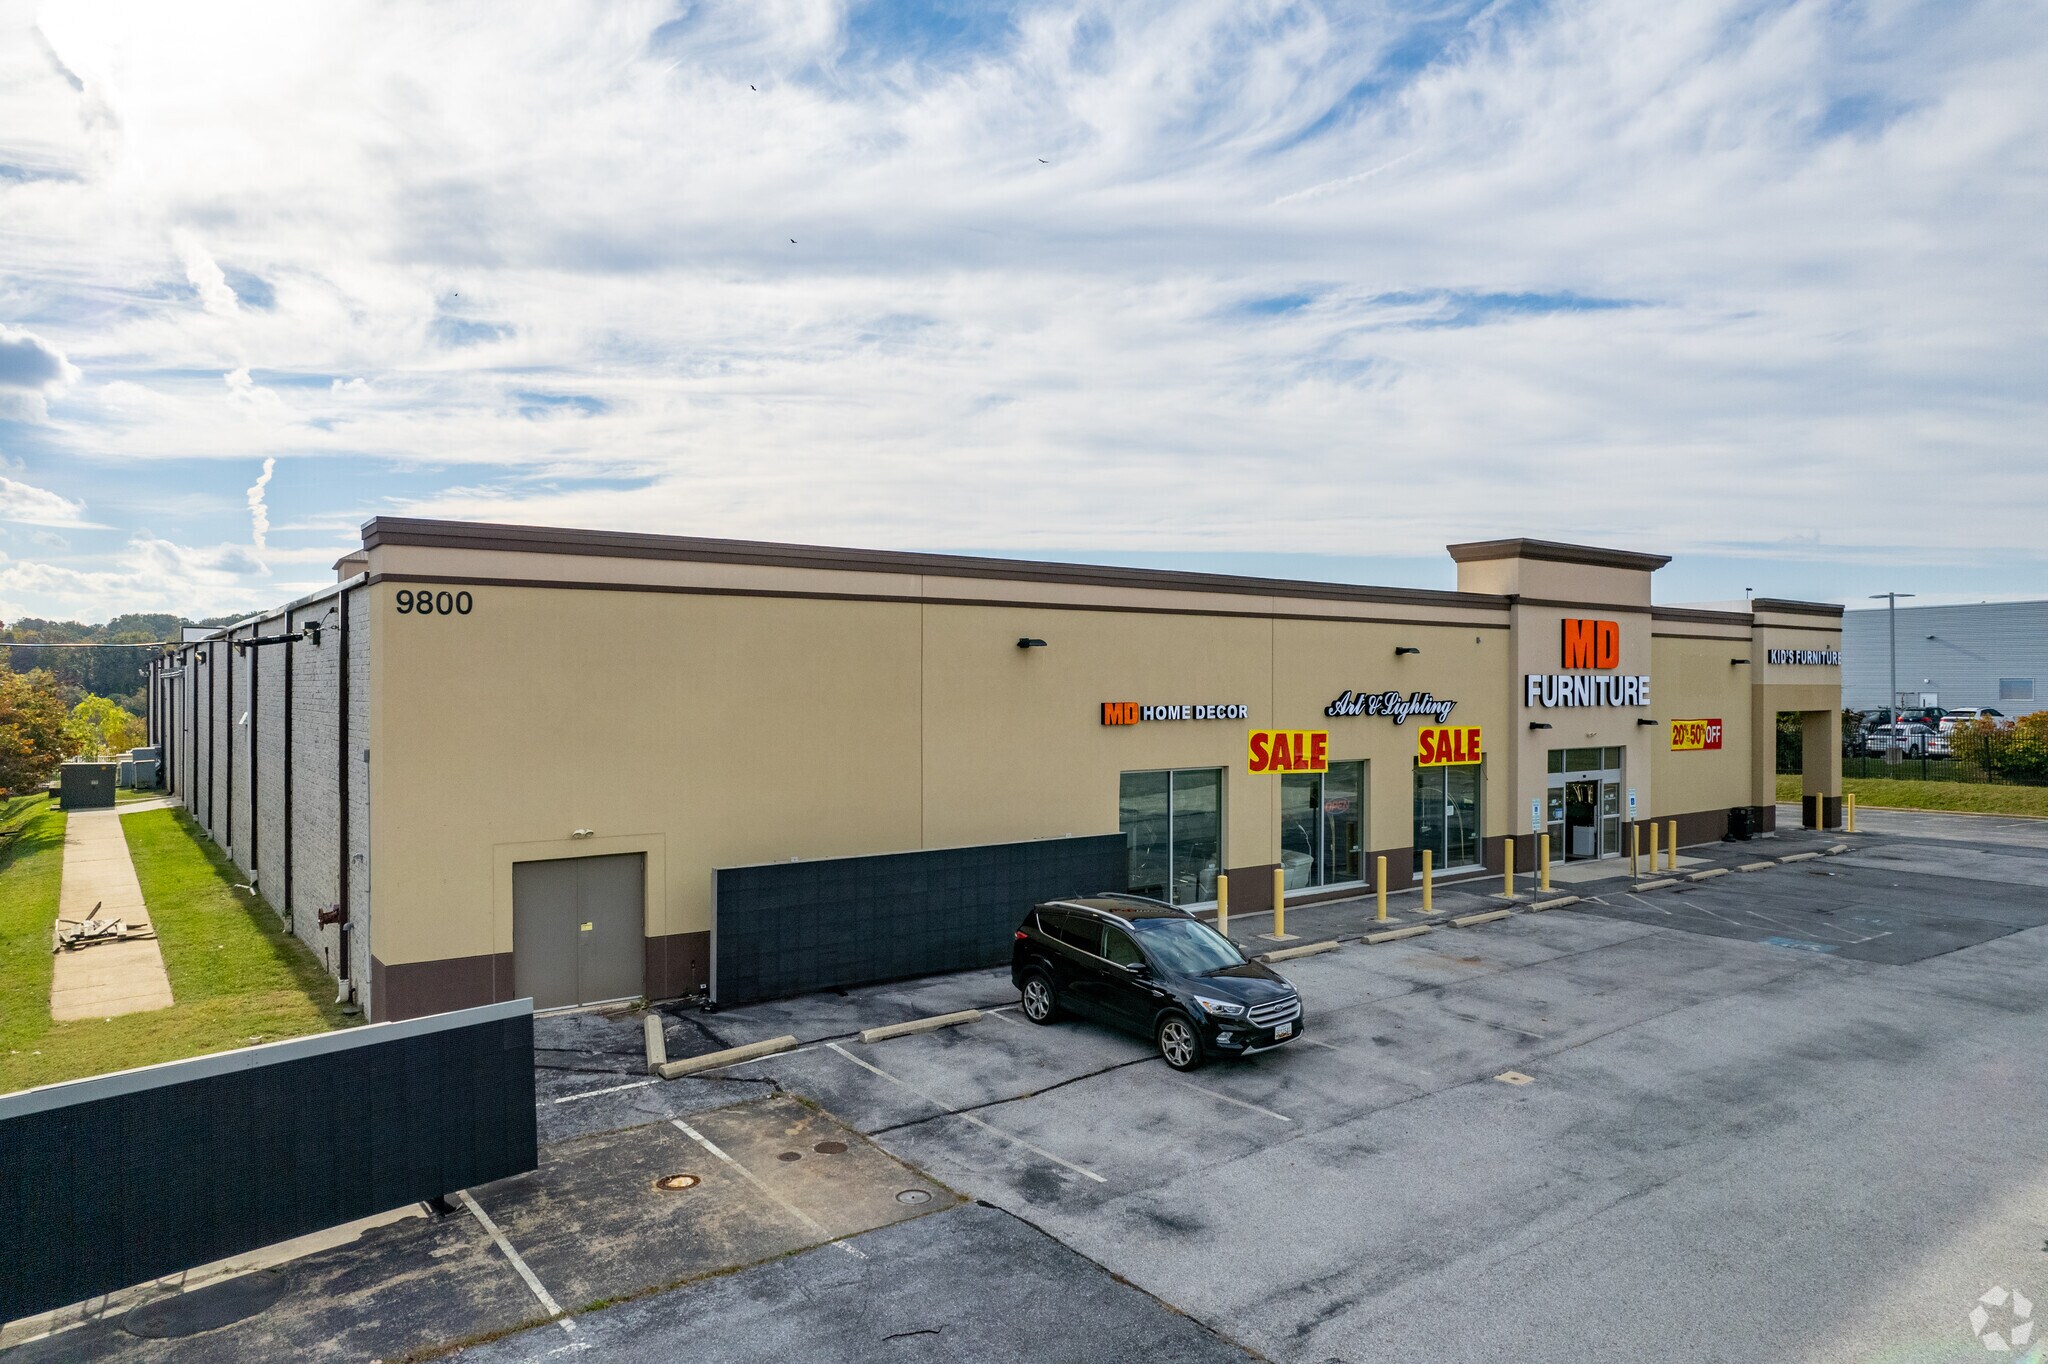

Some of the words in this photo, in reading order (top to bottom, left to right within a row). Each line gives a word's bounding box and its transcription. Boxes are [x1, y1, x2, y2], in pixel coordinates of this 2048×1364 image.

[396, 589, 473, 615] 9800
[1563, 618, 1620, 669] MD
[1770, 649, 1794, 664] KID'S
[1796, 650, 1842, 665] FURNITURE
[1326, 690, 1366, 716] Art
[1379, 691, 1456, 724] Lighting
[1526, 674, 1651, 708] FURNITURE
[1102, 702, 1139, 725] MD
[1142, 705, 1191, 721] HOME
[1195, 704, 1249, 720] DECOR
[1419, 728, 1481, 764] SALE
[1705, 725, 1721, 743] OFF
[1249, 732, 1327, 772] SALE
